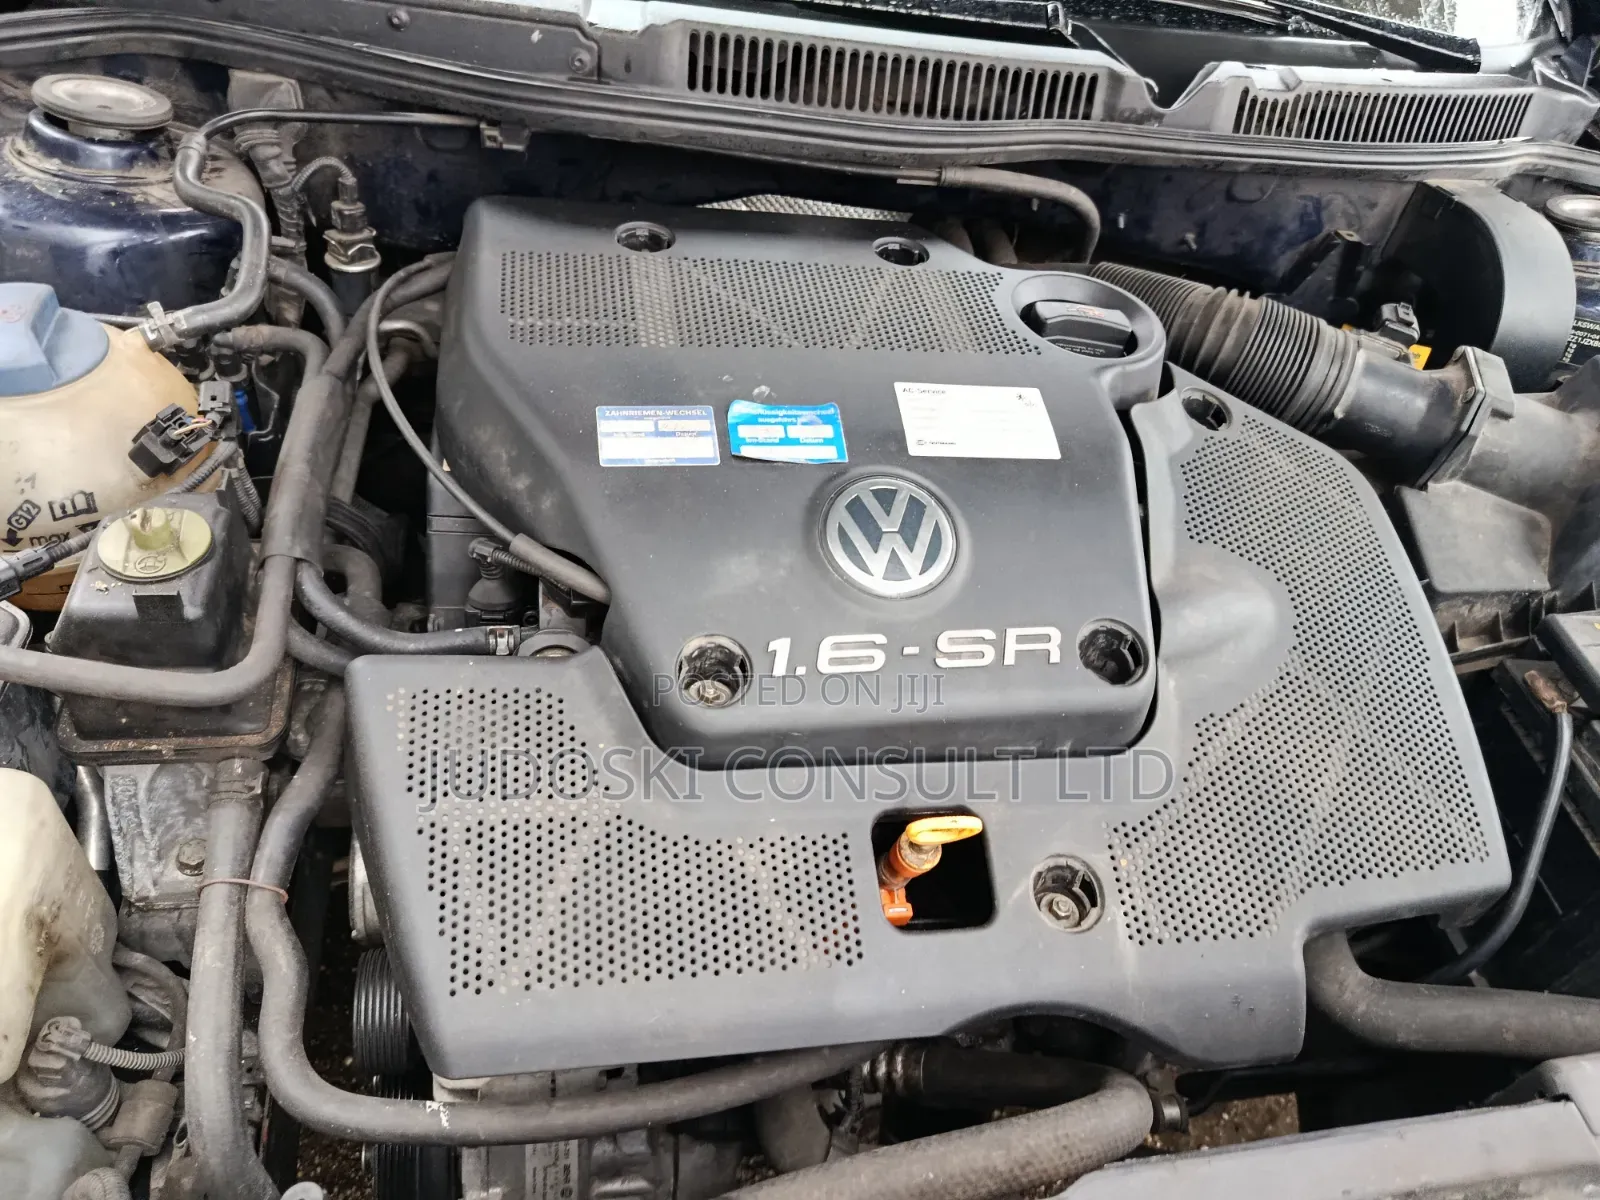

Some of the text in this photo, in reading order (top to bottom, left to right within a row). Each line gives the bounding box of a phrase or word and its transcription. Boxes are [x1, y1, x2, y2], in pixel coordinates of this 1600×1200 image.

[605, 409, 708, 417] ZAHNRIEMEN-WECHSEL
[10, 502, 39, 531] G12
[29, 531, 70, 546] max
